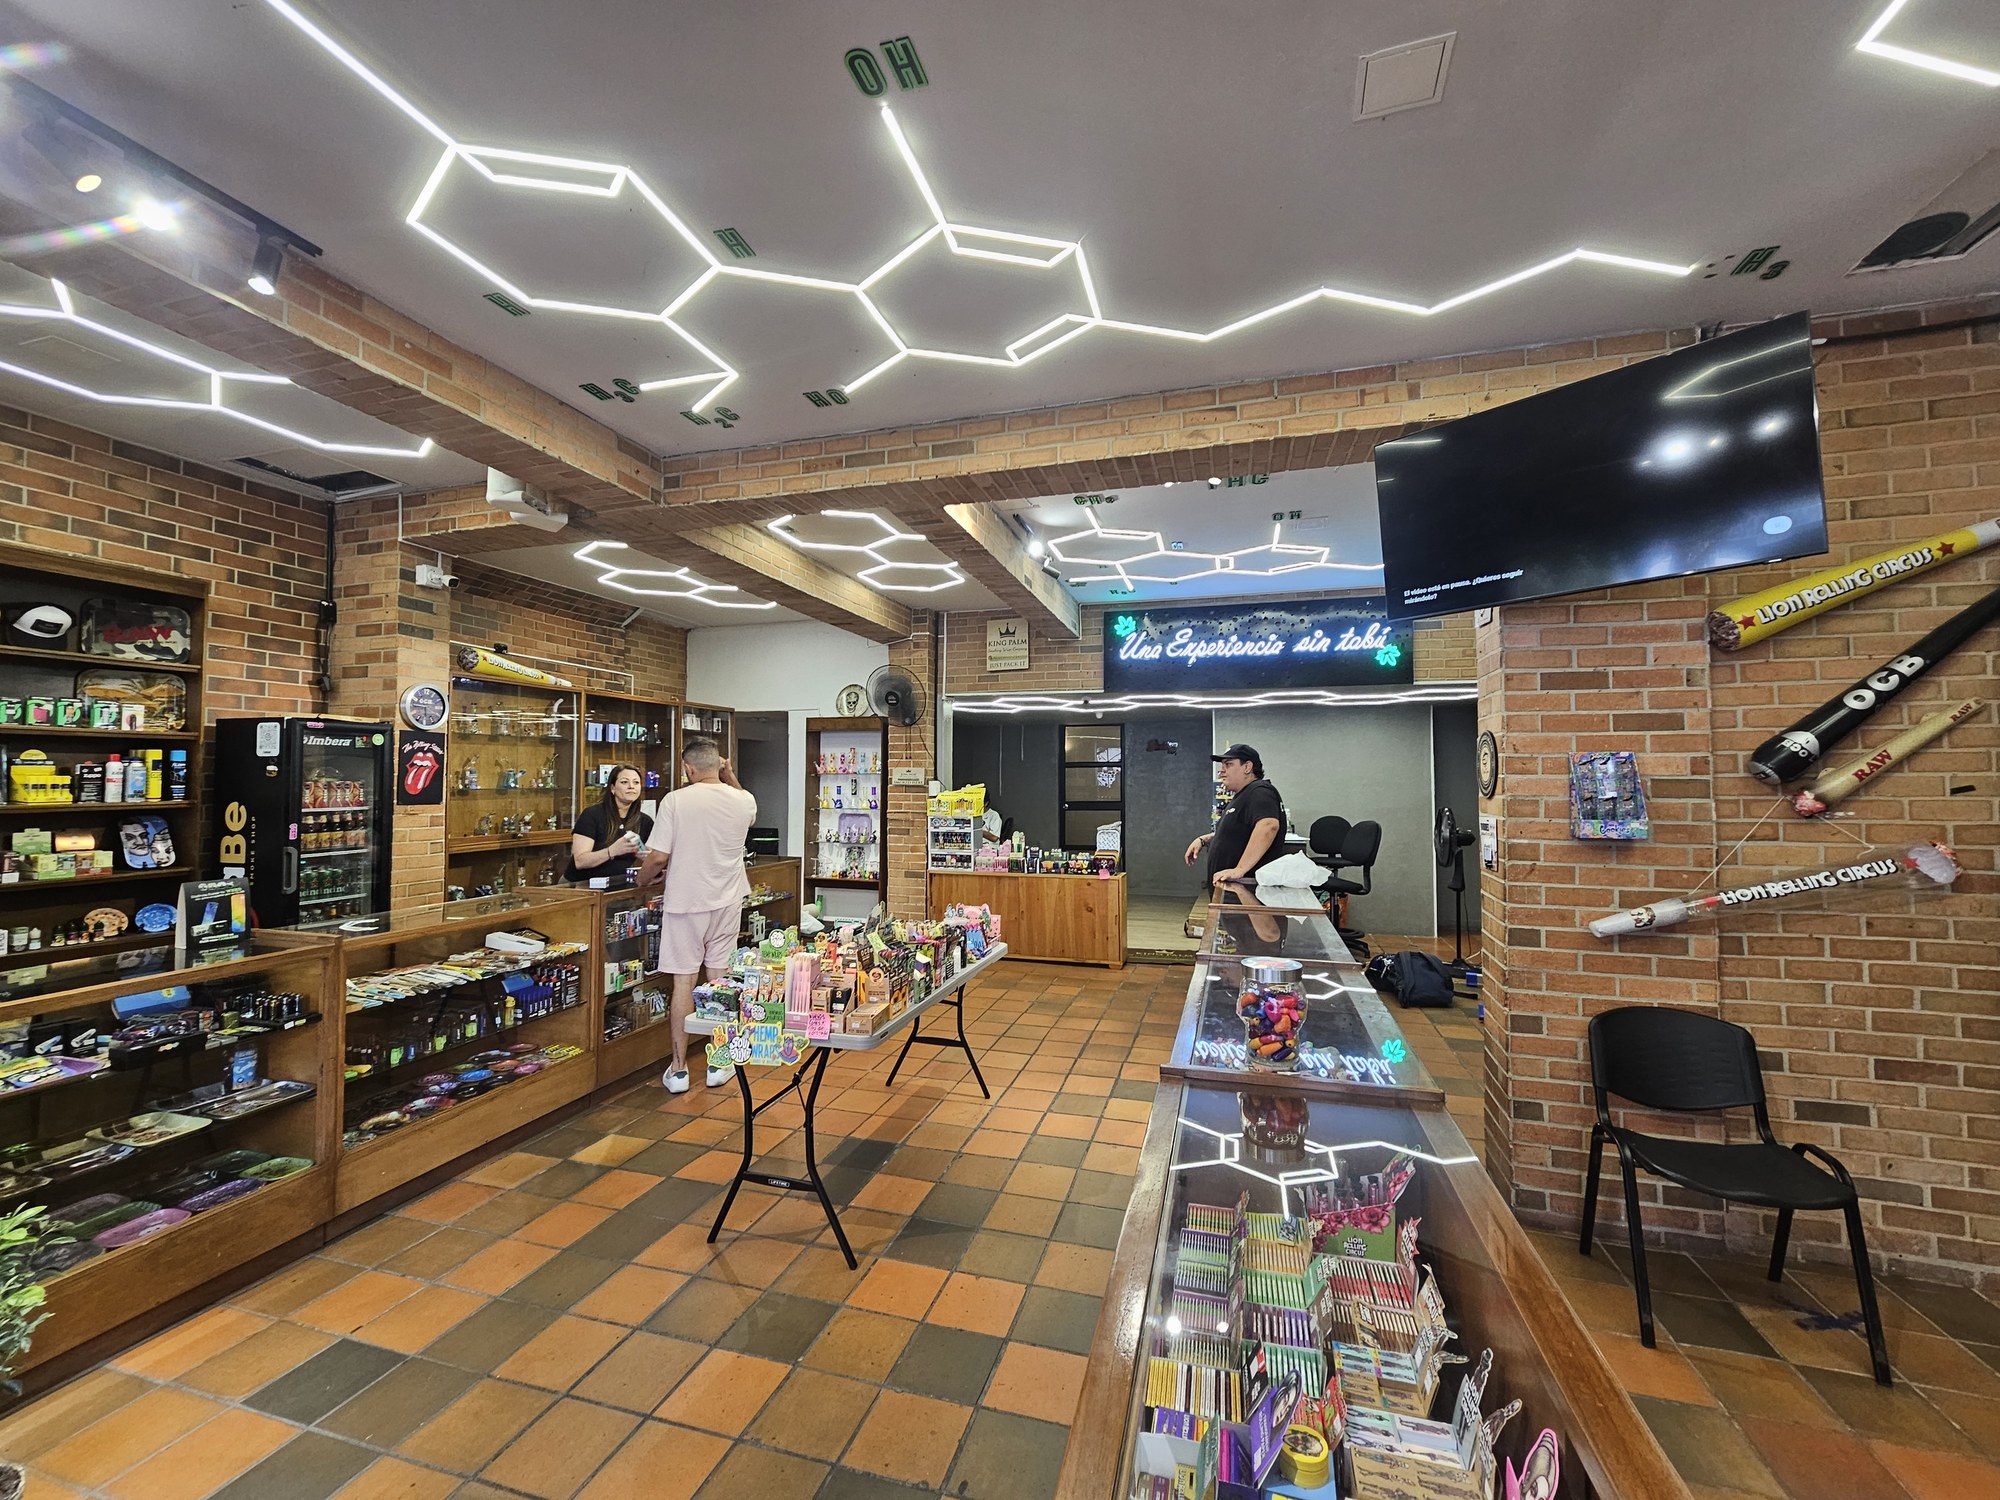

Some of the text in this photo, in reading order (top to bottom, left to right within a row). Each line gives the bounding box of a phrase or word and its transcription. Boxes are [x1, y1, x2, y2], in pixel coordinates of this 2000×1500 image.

[844, 36, 929, 98] OH
[802, 389, 850, 408] HO
[1755, 547, 1935, 624] LION ROLLING CIRCUS
[1008, 638, 1028, 646] PALM
[1118, 621, 1393, 667] Una Experiencia sin tabú
[1843, 654, 1925, 710] OCB
[1950, 702, 1974, 722] RAW
[308, 735, 352, 746] Imbera
[1851, 749, 1893, 783] RAW
[1720, 857, 1899, 906] LION ROLLING CIRCUS
[753, 1025, 779, 1043] HEMP
